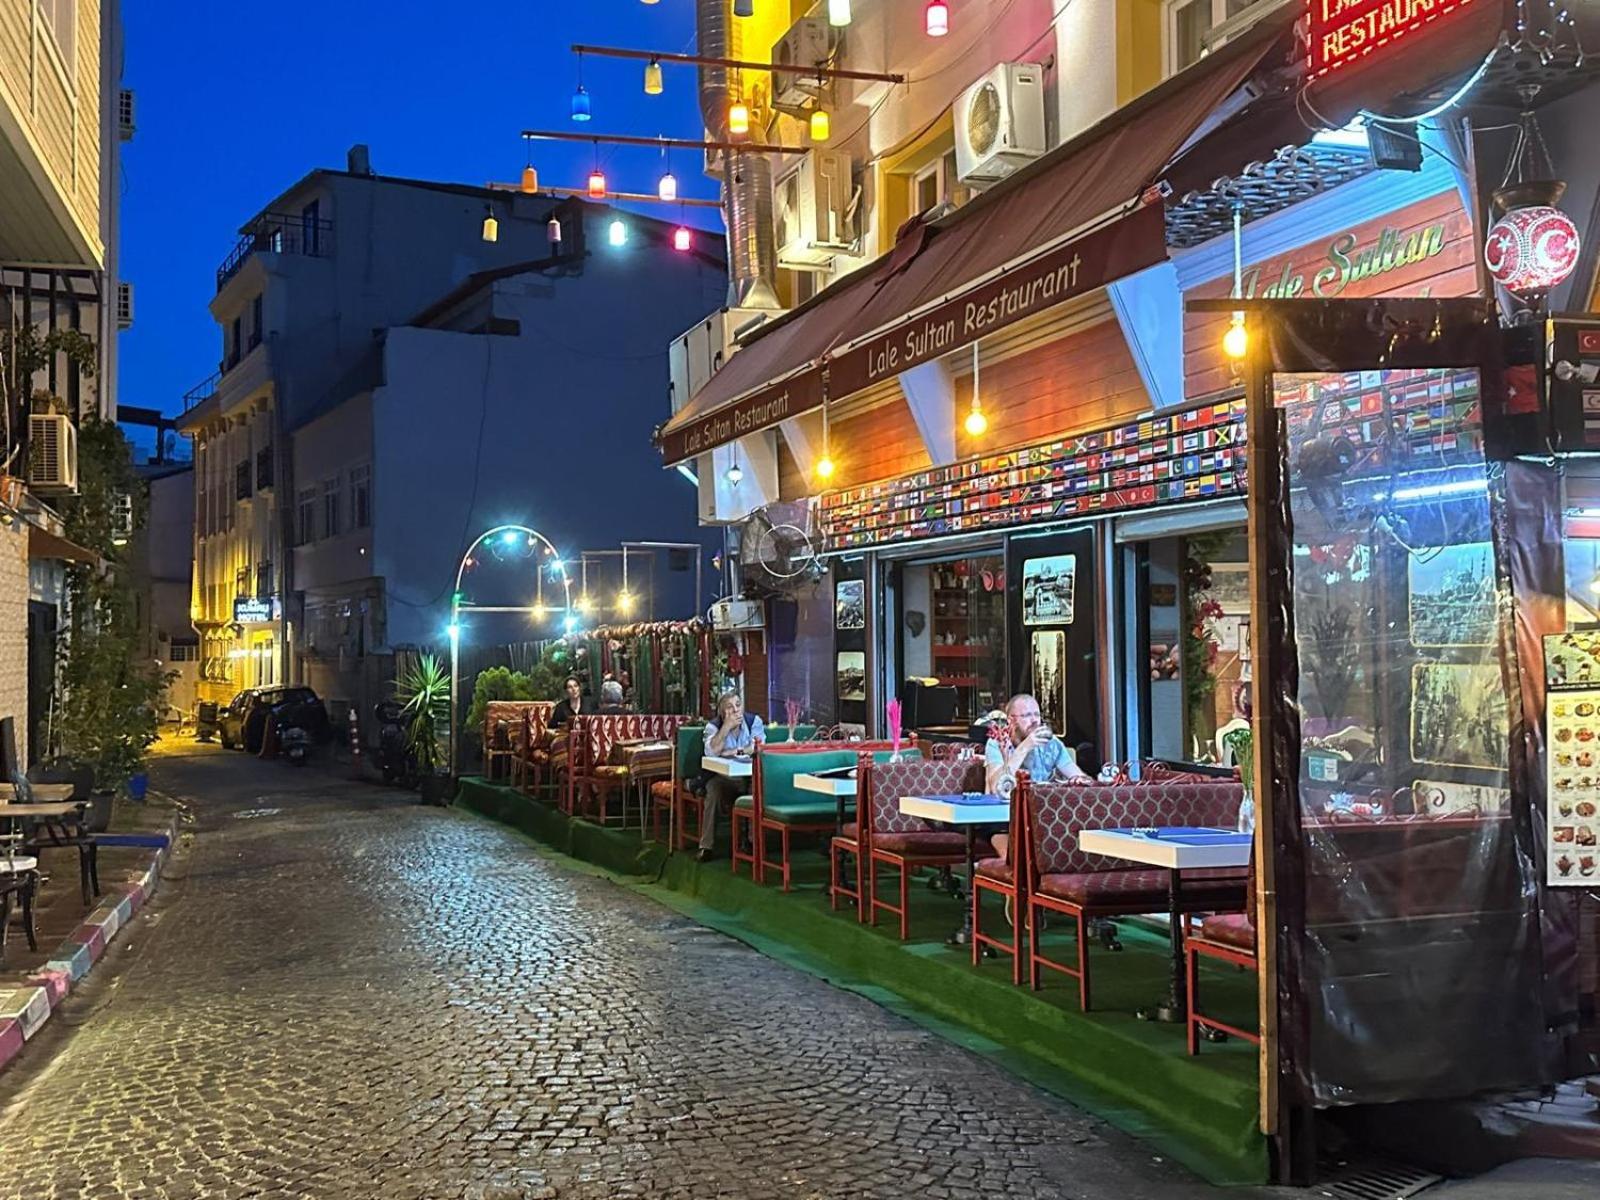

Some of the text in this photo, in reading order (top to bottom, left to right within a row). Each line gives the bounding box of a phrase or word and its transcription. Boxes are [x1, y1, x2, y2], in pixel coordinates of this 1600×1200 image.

[1312, 223, 1446, 299] Sultan
[868, 253, 1082, 378] Lale Sultan Restaurant
[684, 389, 789, 454] Lale Sultan Restaurant
